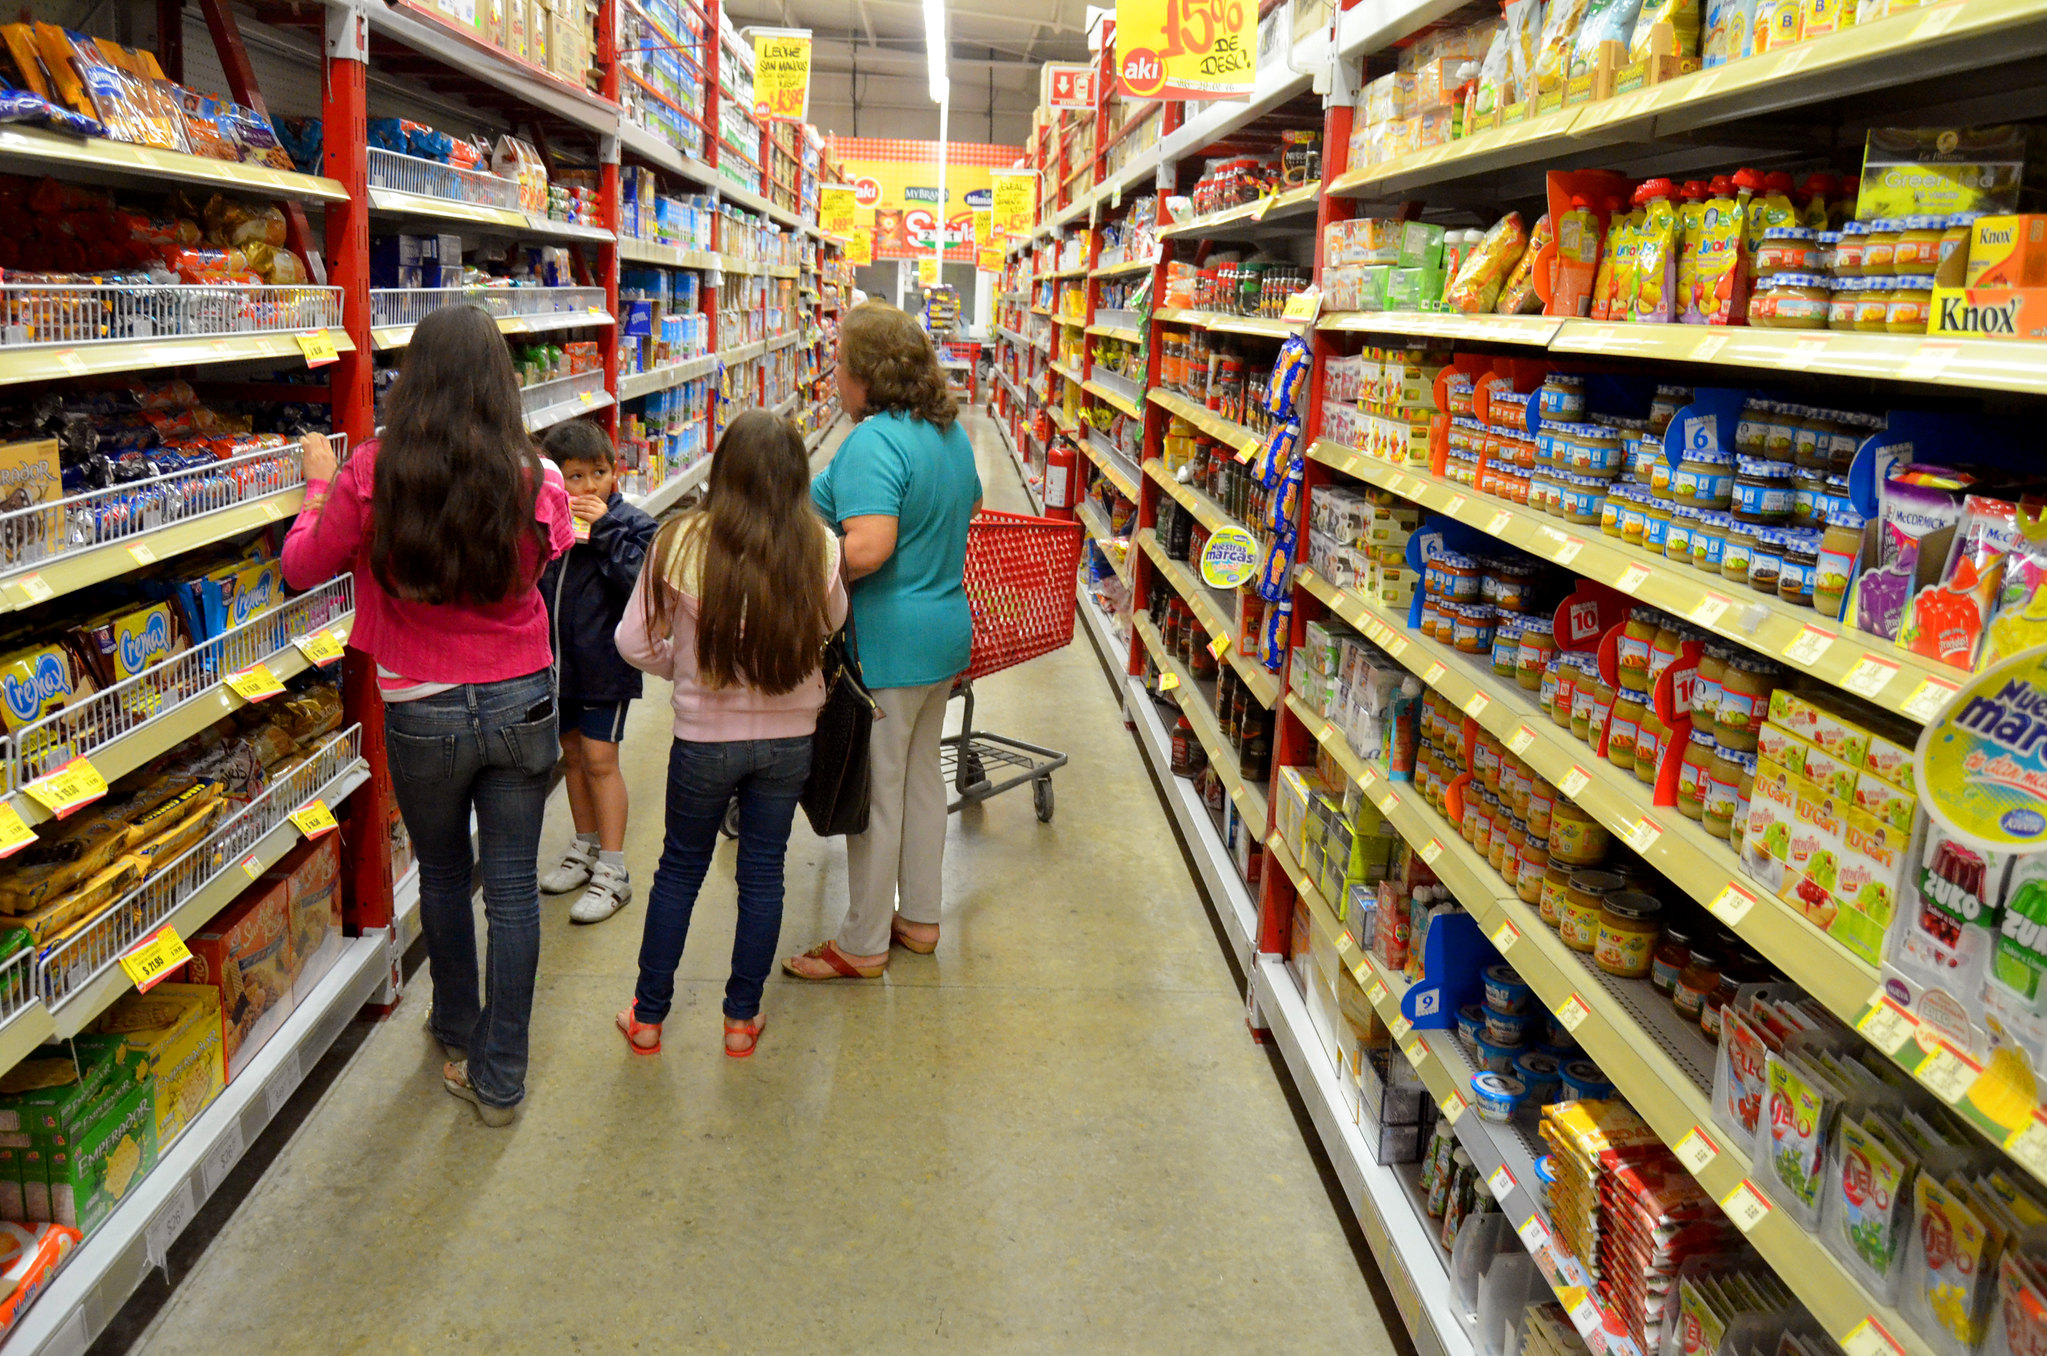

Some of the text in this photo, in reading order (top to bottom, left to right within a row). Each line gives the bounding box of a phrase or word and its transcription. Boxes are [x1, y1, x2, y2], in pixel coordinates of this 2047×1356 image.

[1214, 35, 1239, 54] DE
[1123, 56, 1160, 80] aki
[855, 183, 877, 198] aki
[1884, 171, 1995, 188] Green tea
[923, 231, 931, 241] 2
[1979, 225, 2015, 245] Knox
[1938, 296, 2016, 335] Knox
[1693, 427, 1709, 450] 6
[1205, 550, 1255, 565] marcas
[1211, 542, 1247, 553] Nuestras
[1573, 610, 1597, 632] 10
[120, 611, 171, 674] Cremax
[4, 653, 72, 720] Cremax
[1992, 677, 2047, 719] Nue
[1984, 753, 2022, 780] dan
[1756, 774, 1793, 808] D'Gari
[1799, 799, 1840, 837] D'Gari
[1849, 829, 1894, 868] D'Gari
[1923, 868, 1980, 921] ZUKO
[142, 955, 165, 976] $ 21.95
[1422, 995, 1434, 1010] 9
[1887, 983, 1910, 1003] NUEVA
[77, 1097, 153, 1181] EMPERADOR
